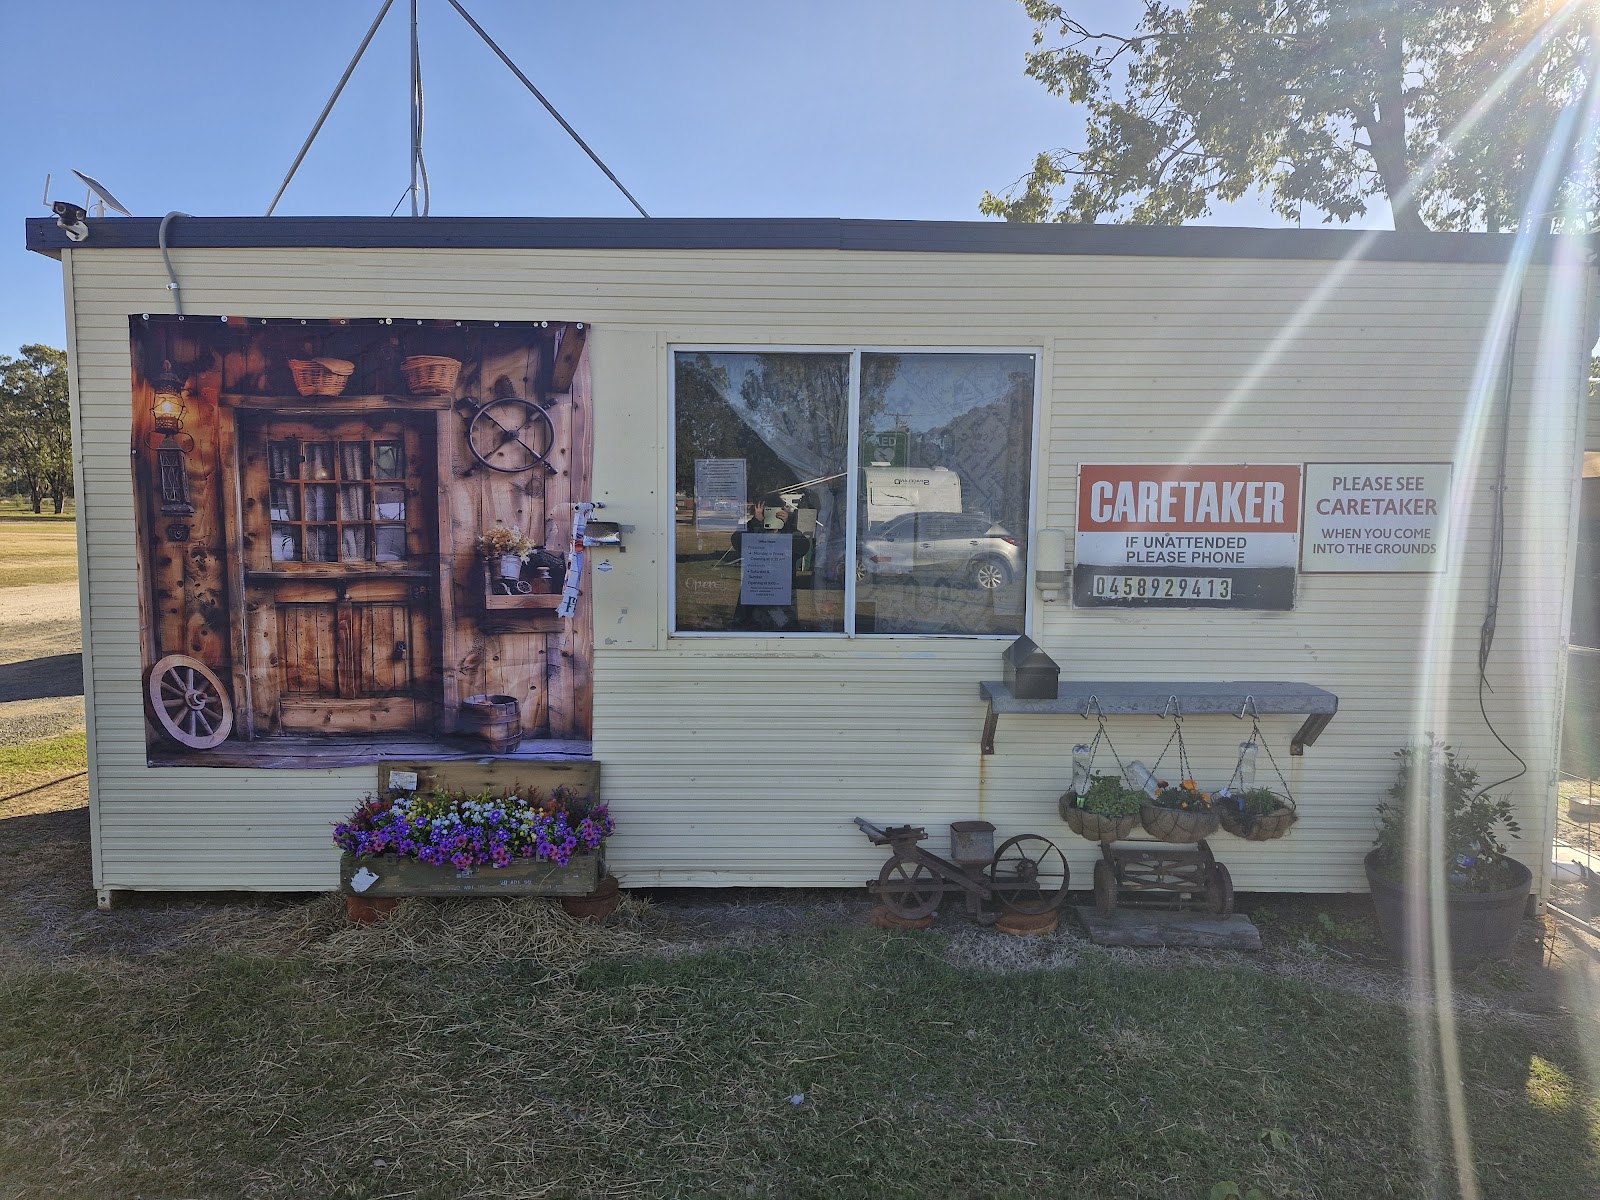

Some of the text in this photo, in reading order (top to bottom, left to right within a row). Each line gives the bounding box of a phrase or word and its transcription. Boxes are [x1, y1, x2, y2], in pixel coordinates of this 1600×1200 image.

[873, 436, 897, 447] AED
[1332, 476, 1425, 491] PLEASE SEE
[1091, 480, 1285, 524] CARETAKER
[1316, 498, 1438, 516] CARETAKER
[1321, 528, 1431, 539] WHEN YOU COME
[1125, 536, 1247, 549] IF UNATTENDED
[1312, 543, 1437, 554] INTO THE GROUNDS
[1126, 551, 1245, 563] PLEASE PHONE
[1096, 576, 1230, 598] 0458929413
